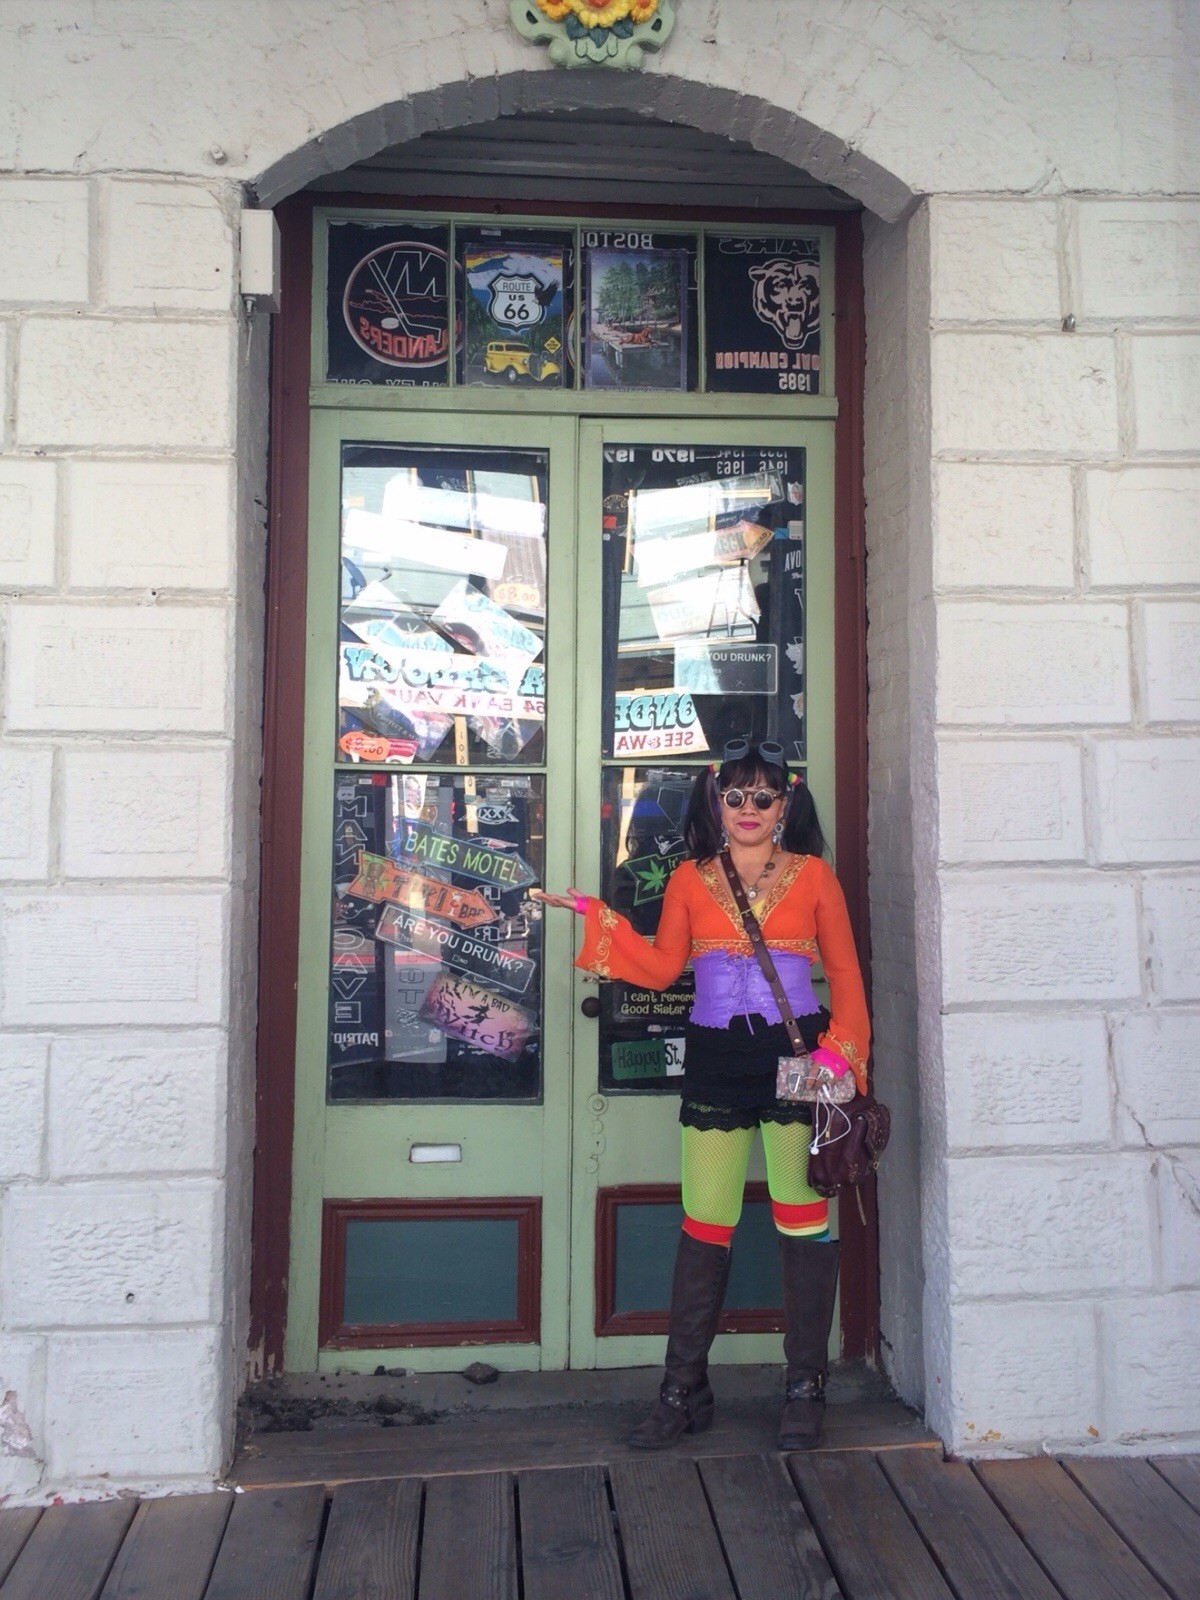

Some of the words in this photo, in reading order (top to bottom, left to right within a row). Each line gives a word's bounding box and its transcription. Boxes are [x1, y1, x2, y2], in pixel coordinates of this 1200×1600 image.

[502, 282, 532, 291] ROUTE
[503, 303, 530, 320] 66
[730, 652, 772, 662] DRUNK?
[404, 830, 459, 864] BATES
[462, 849, 520, 884] MOTEL
[392, 914, 424, 935] ARE
[428, 924, 460, 949] YOU
[461, 940, 524, 973] DRUNK?
[481, 994, 490, 1005] A
[491, 997, 511, 1013] BAD
[623, 991, 628, 1002] I
[630, 990, 658, 1003] can't
[620, 1003, 650, 1014] Good
[652, 1003, 686, 1015] Sister
